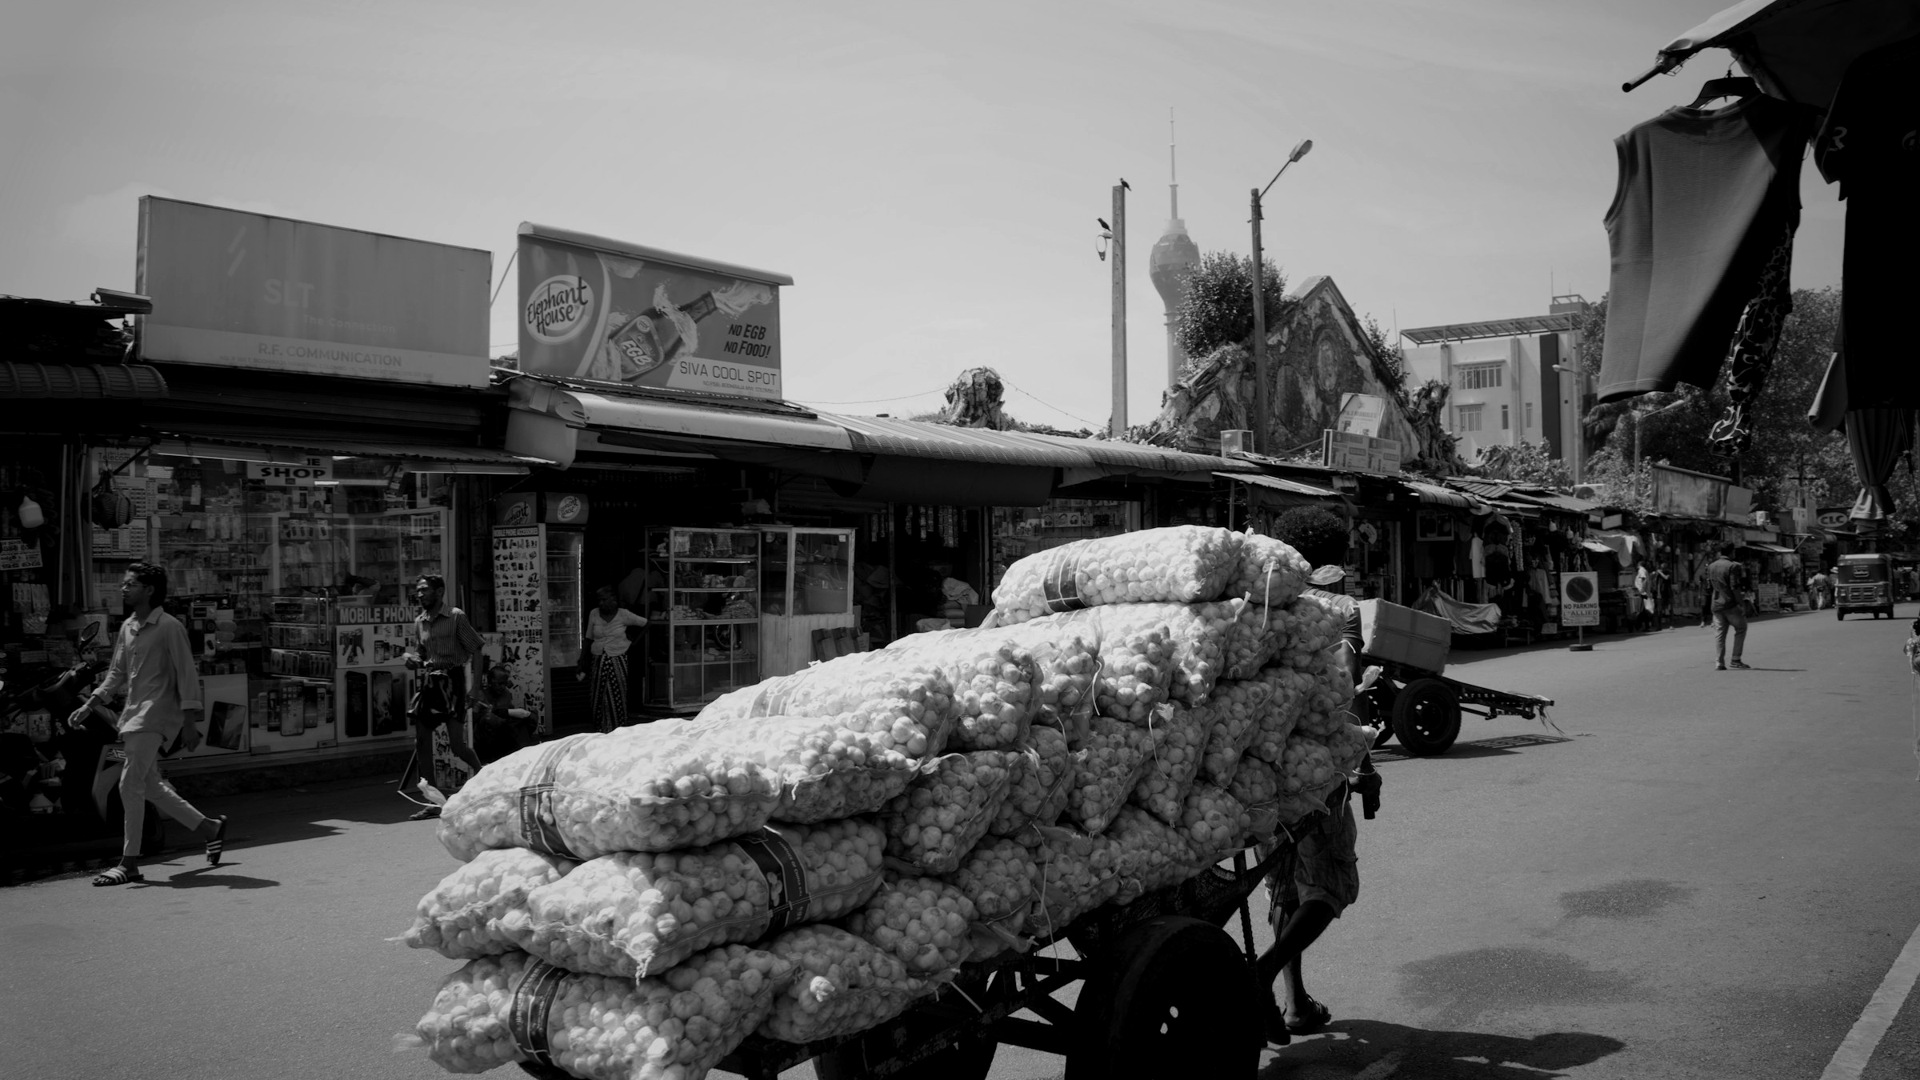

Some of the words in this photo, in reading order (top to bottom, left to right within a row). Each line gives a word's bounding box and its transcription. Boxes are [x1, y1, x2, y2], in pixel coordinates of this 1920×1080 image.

[263, 278, 315, 309] SLT
[527, 276, 589, 325] Elephant
[536, 304, 576, 336] House
[728, 323, 742, 337] NO
[743, 324, 767, 341] EGB
[258, 343, 283, 356] R.F.
[286, 345, 402, 367] COMMUNICATION
[620, 339, 652, 366] EGB
[723, 340, 738, 354] NO
[738, 340, 772, 359] FOOD!
[679, 360, 708, 378] SIVA
[712, 365, 744, 382] COOL
[747, 370, 777, 386] SPOT
[260, 467, 326, 479] SHOP
[1820, 515, 1844, 525] CLC
[339, 607, 380, 623] MOBILE
[383, 606, 419, 622] PHONE
